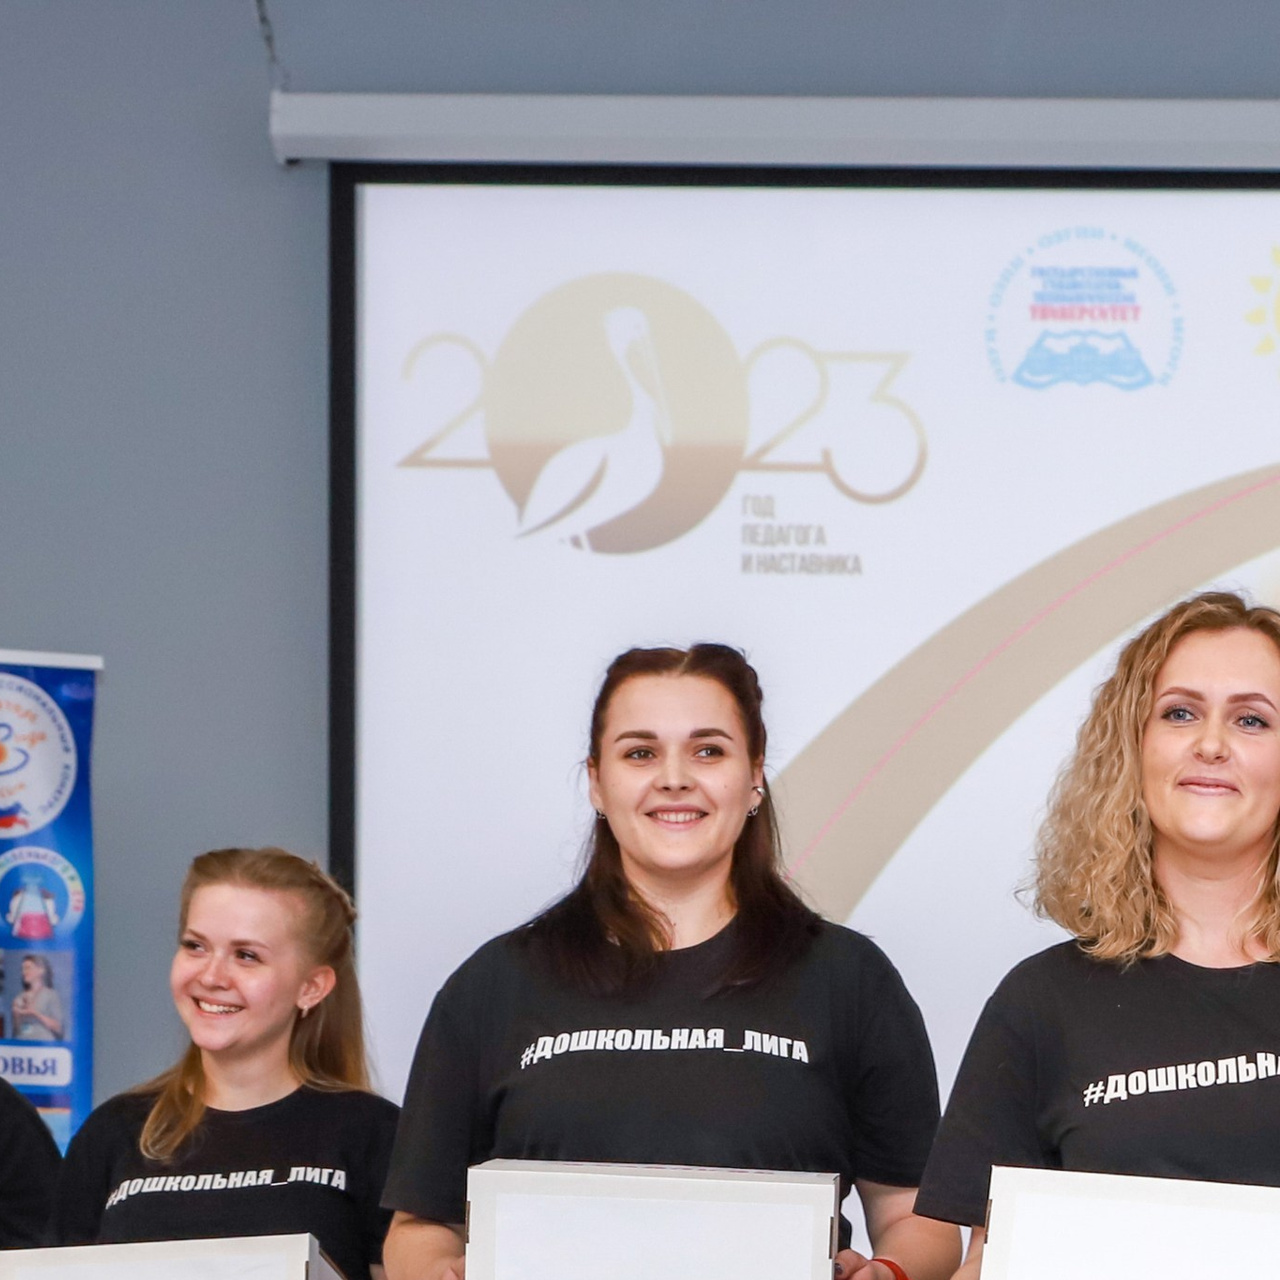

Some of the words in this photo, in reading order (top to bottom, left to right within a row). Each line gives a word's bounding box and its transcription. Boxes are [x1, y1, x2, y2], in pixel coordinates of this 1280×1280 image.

[741, 494, 775, 518] ГОД
[741, 523, 828, 547] ПЕДАГОГА
[521, 1029, 809, 1069] #ДОШКОЛЬНАЯ_ЛИГА
[105, 1166, 346, 1210] #ДОШКОЛЬНАЯ_ЛИГА
